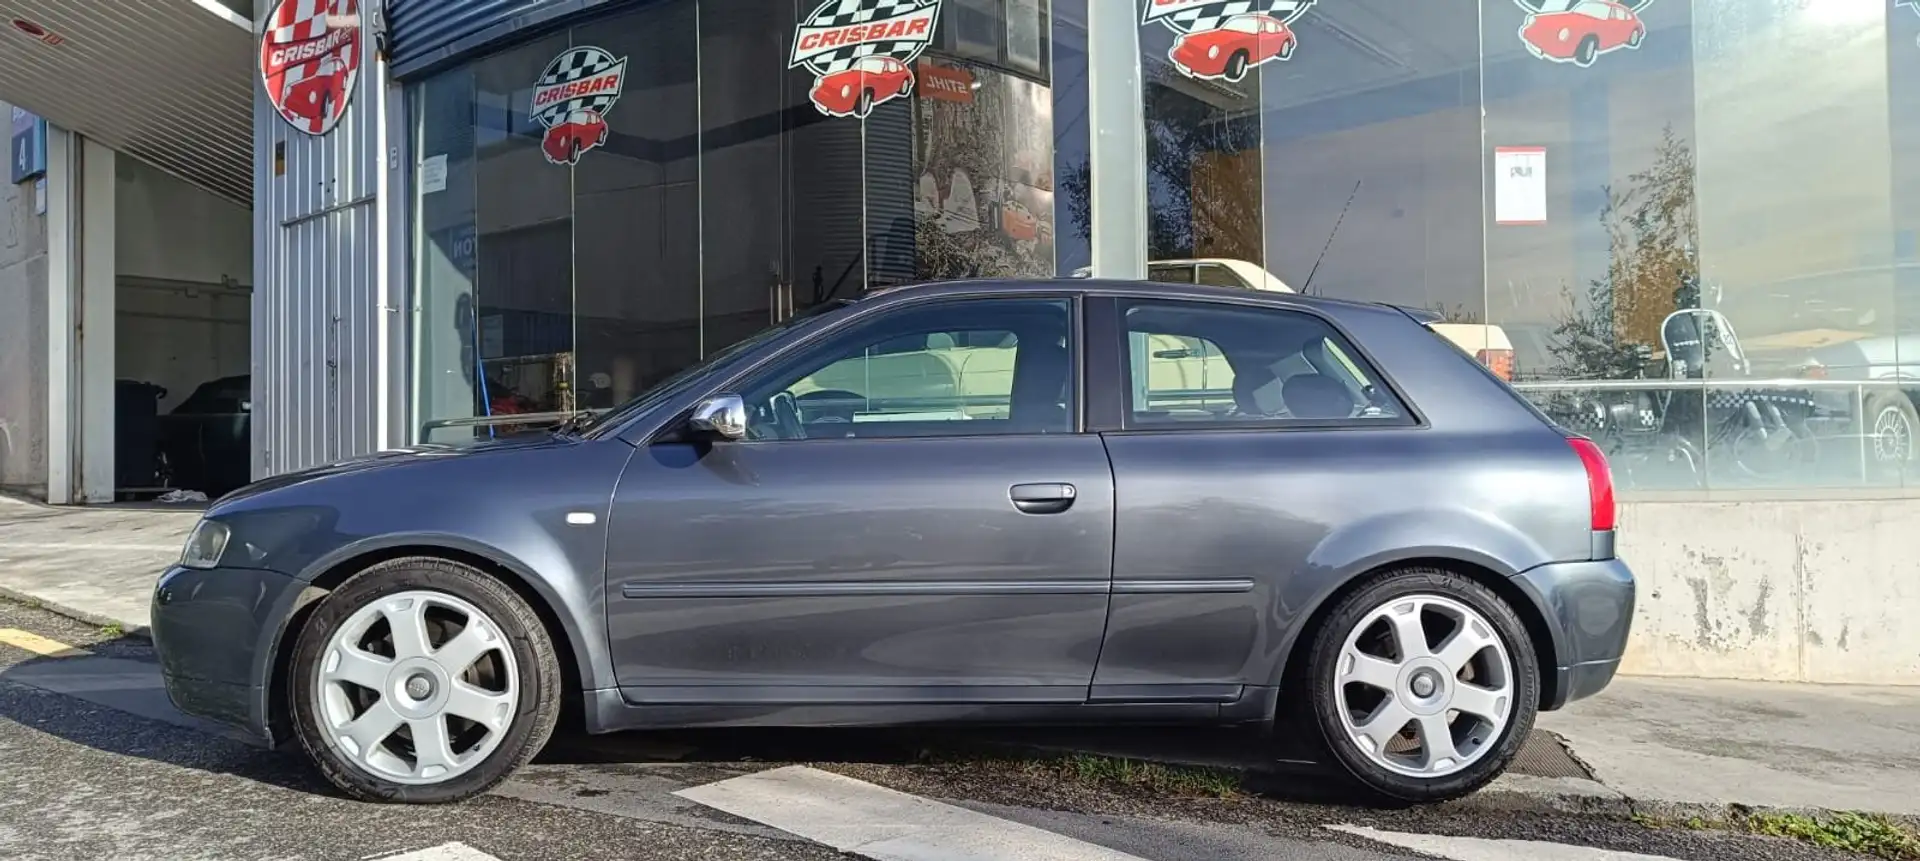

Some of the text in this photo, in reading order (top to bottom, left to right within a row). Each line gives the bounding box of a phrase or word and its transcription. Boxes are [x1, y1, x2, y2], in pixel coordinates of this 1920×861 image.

[270, 28, 341, 67] CRISBAR
[800, 18, 929, 50] CRISBAR
[535, 74, 619, 106] CRISBAR
[19, 137, 26, 171] 4
